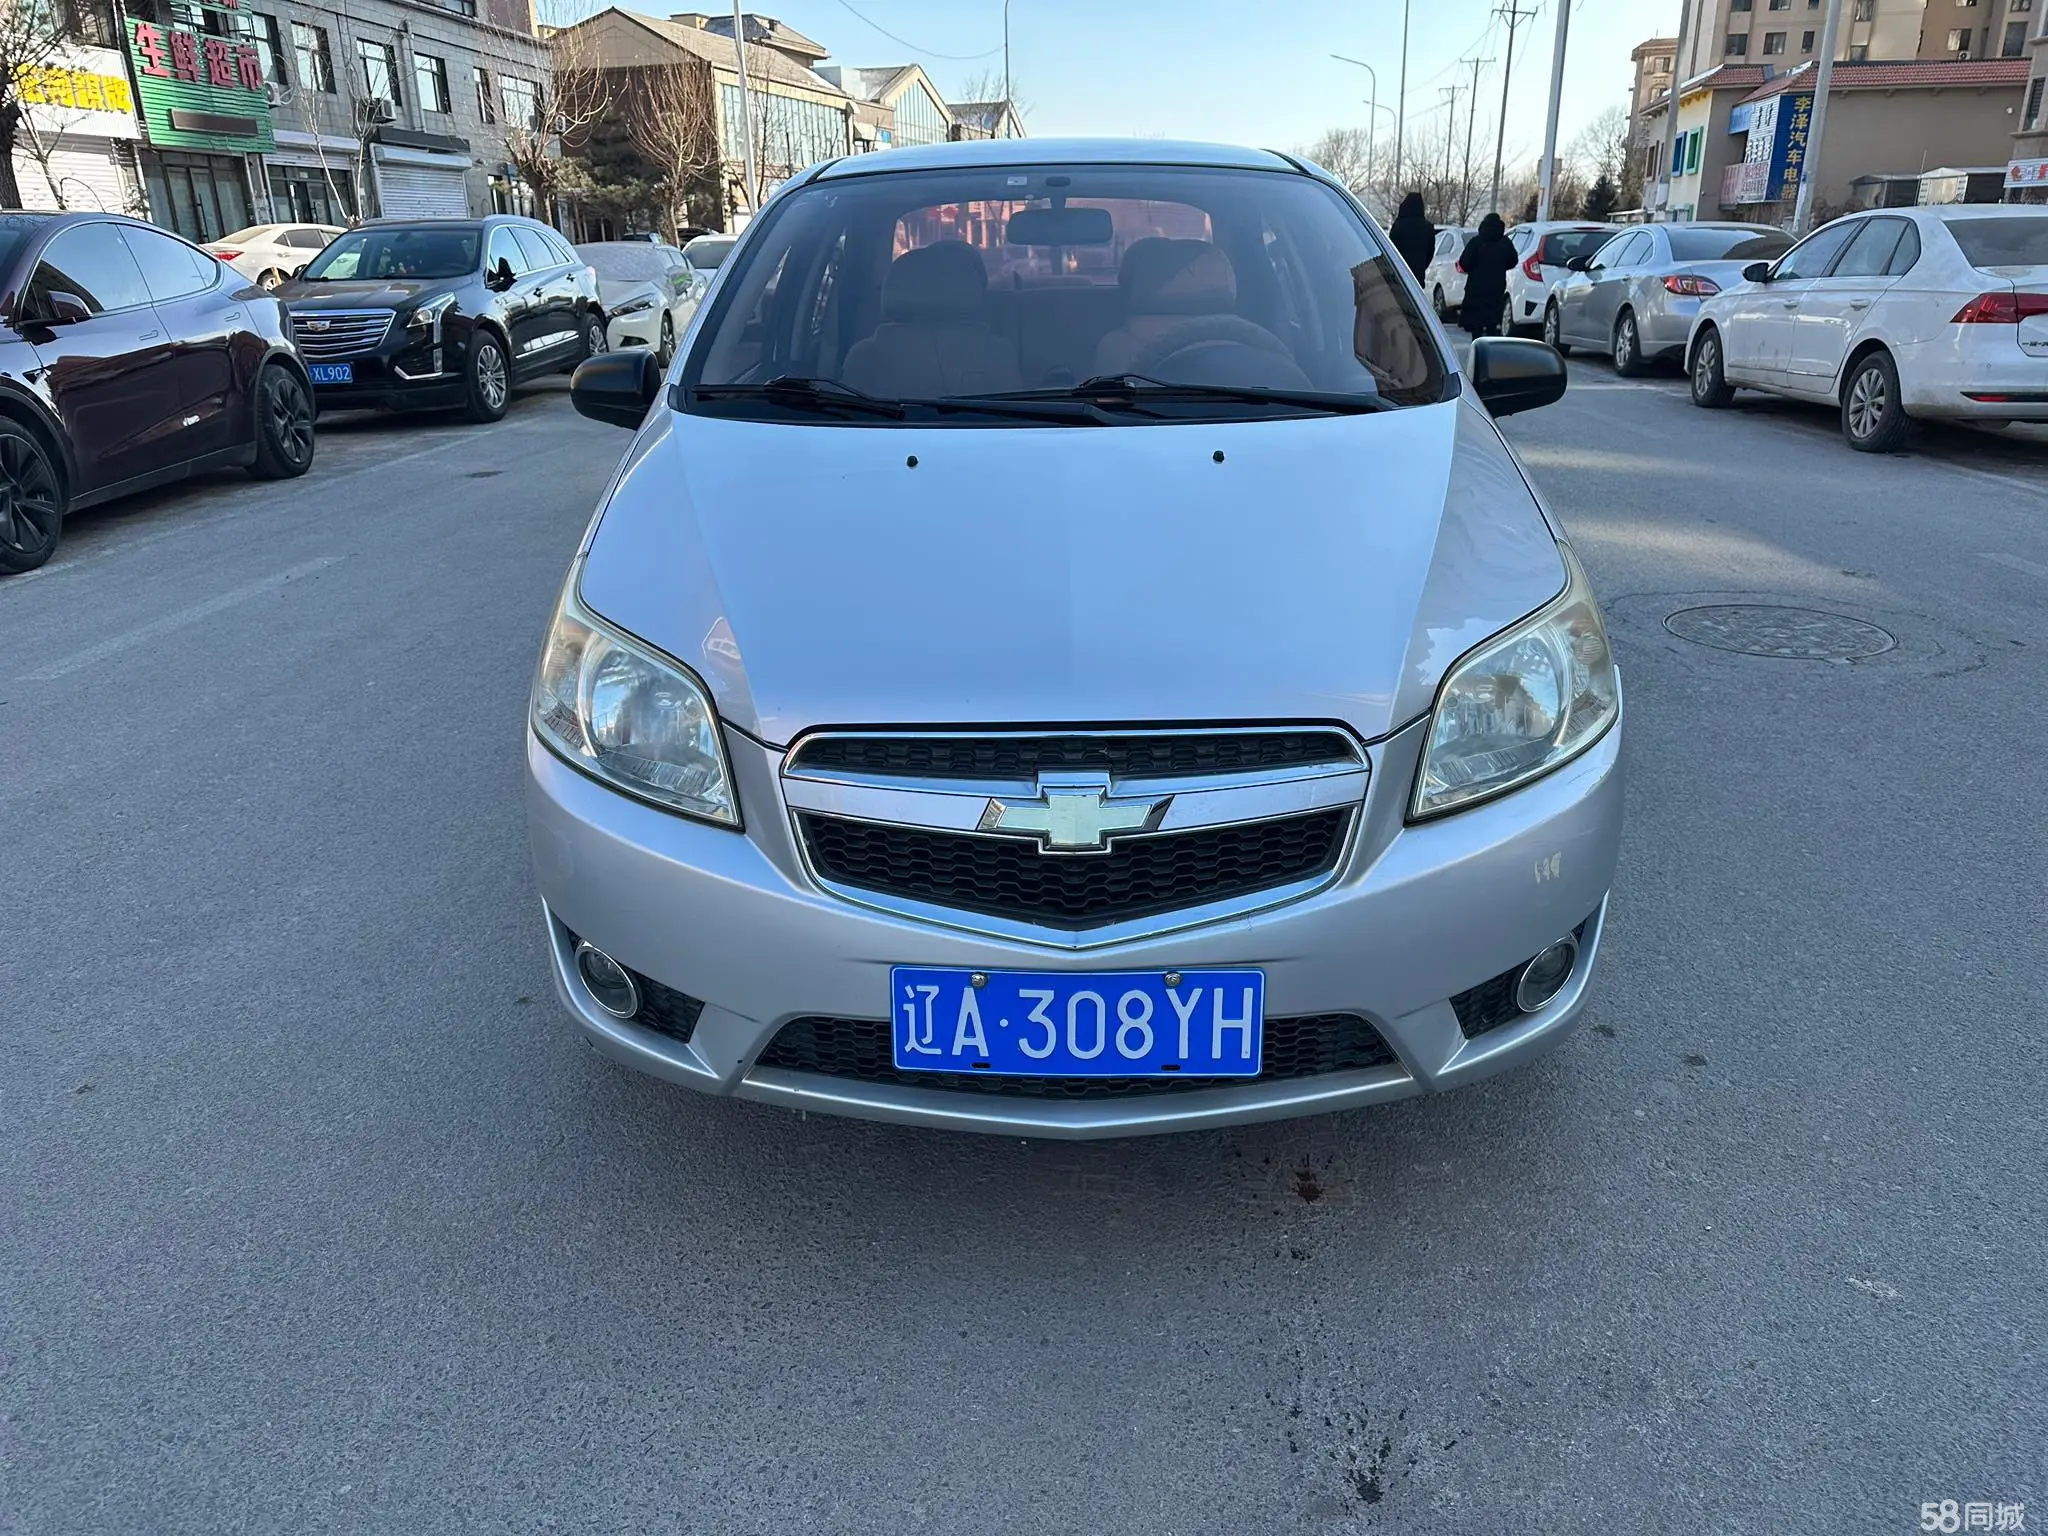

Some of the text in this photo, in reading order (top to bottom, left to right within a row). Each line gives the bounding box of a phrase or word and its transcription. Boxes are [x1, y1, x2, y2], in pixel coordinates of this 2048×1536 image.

[134, 22, 263, 91] 生鲜超市
[1781, 96, 1812, 200] 李泽汽车电器
[902, 984, 1254, 1060] 辽A·308YH
